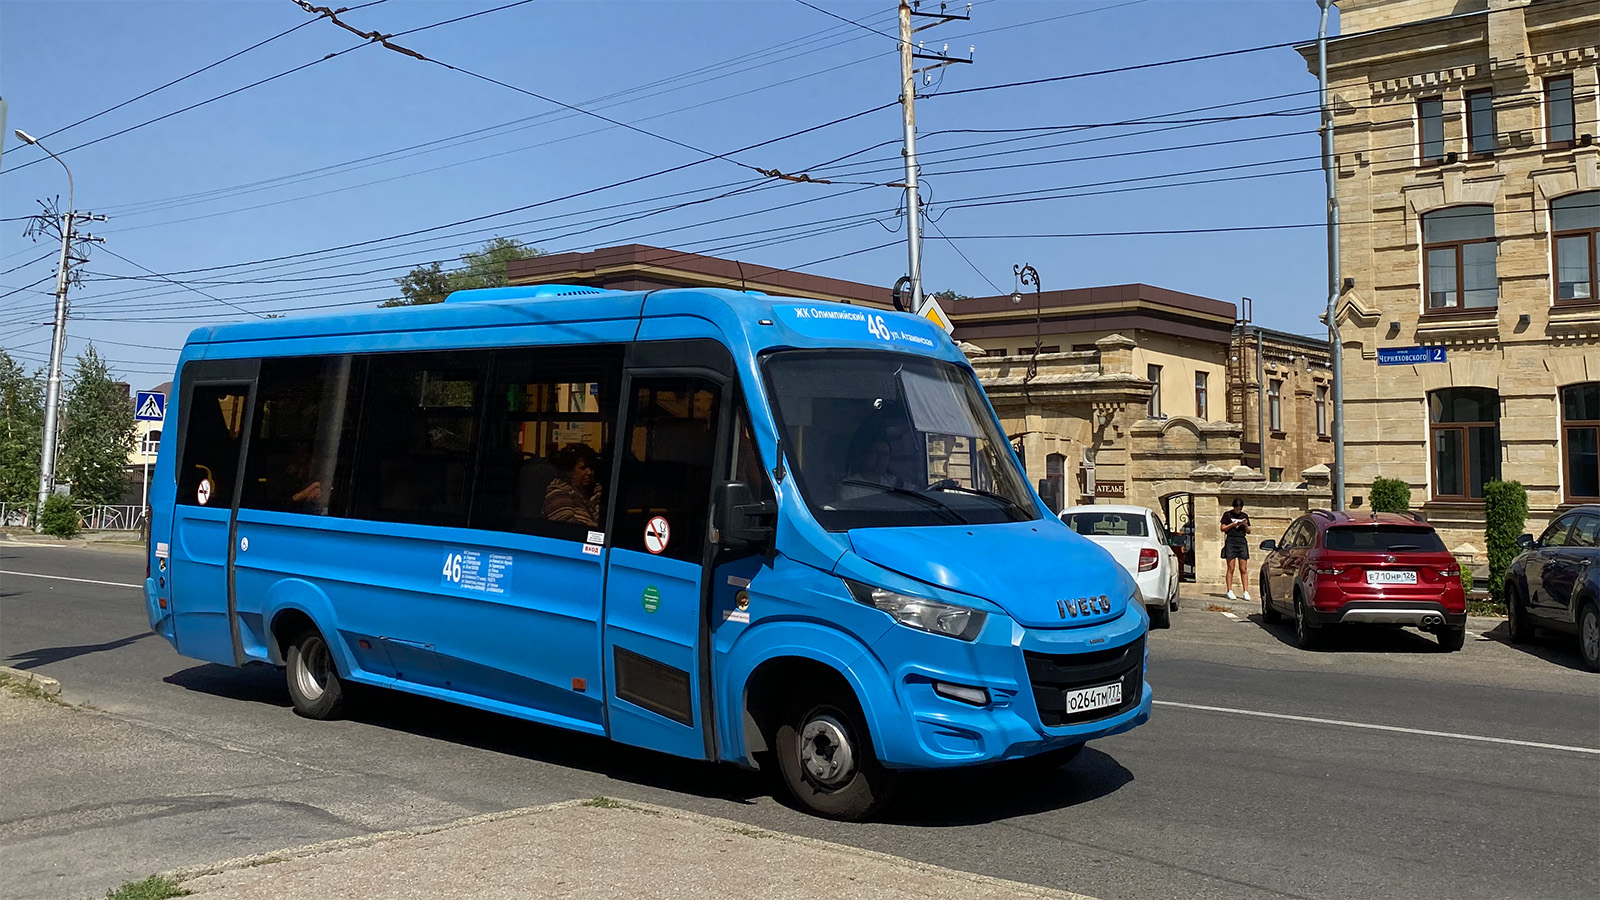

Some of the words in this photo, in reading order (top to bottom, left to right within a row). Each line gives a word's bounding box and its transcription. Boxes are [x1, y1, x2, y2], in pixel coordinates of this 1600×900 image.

[794, 307, 811, 318] ЖК
[810, 307, 867, 322] Олимпийский
[867, 314, 890, 341] 46
[890, 331, 901, 341] ул.
[1433, 348, 1442, 361] 2
[1096, 485, 1124, 493] АТЕЛЬЕ
[585, 546, 599, 554] ВХОД
[442, 553, 463, 583] 46
[1056, 595, 1111, 619] IVECO
